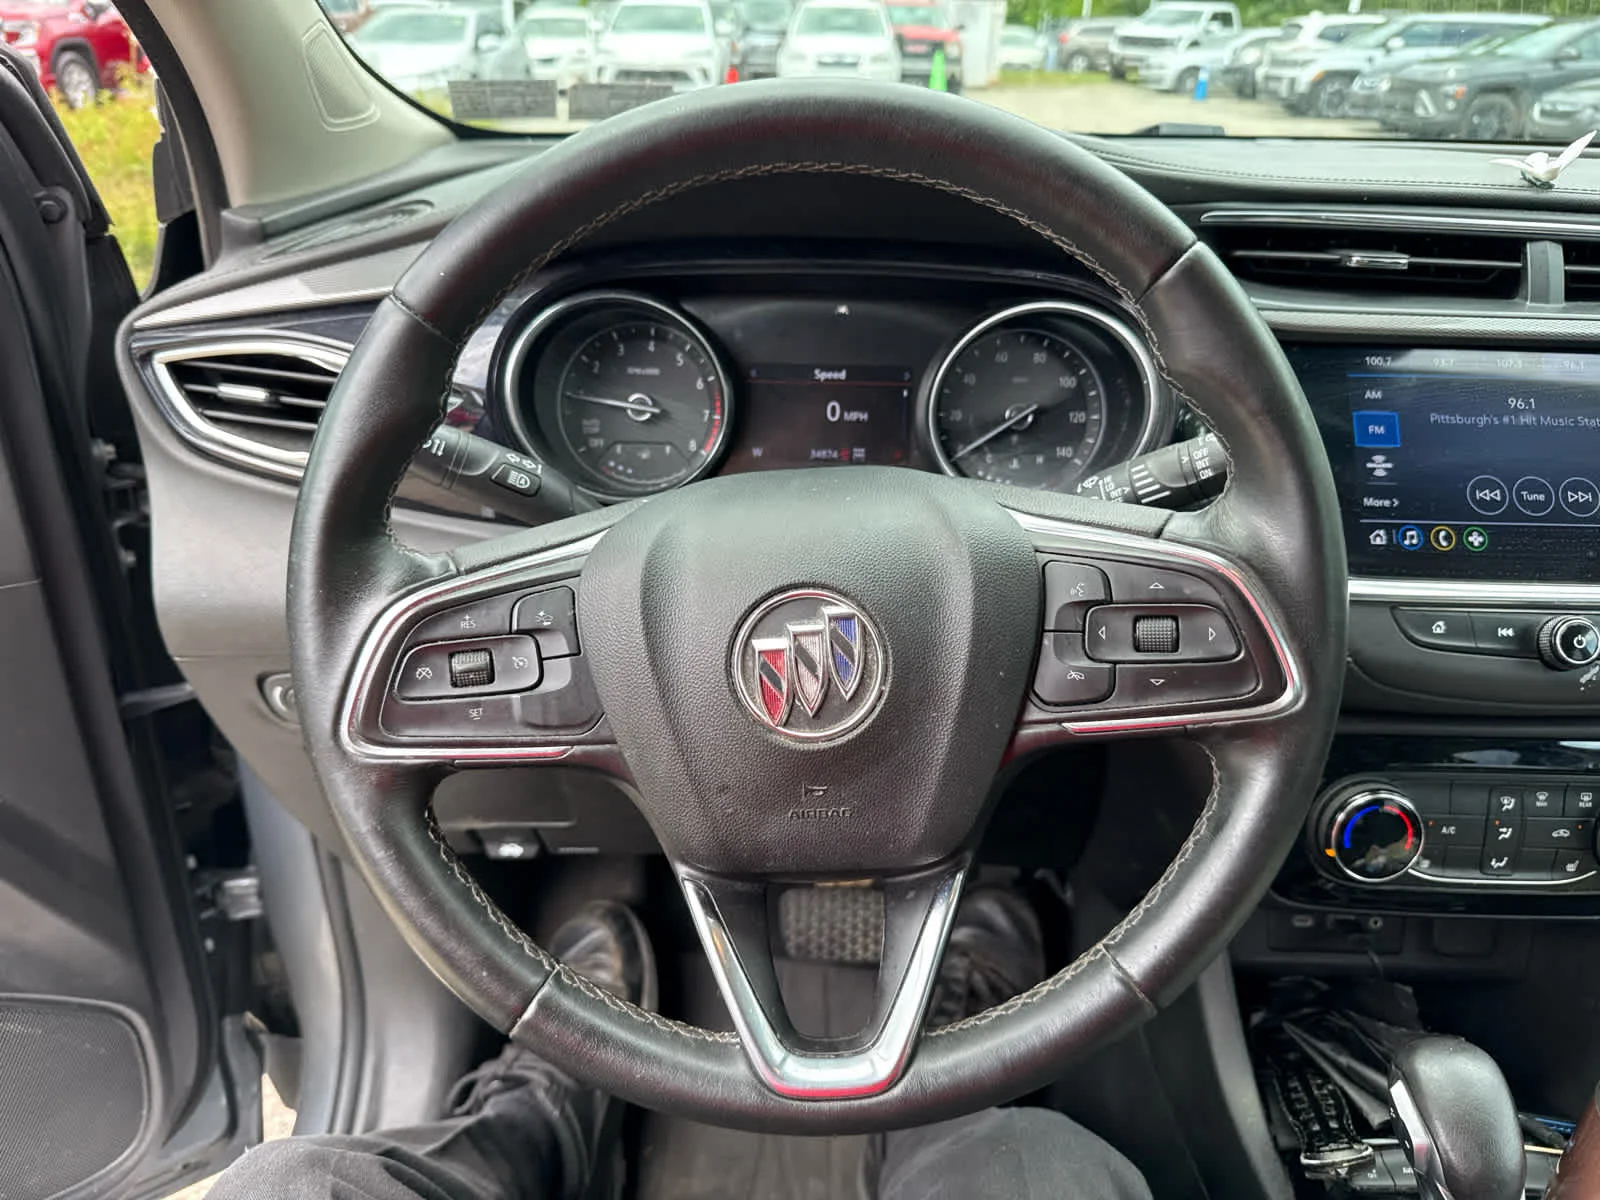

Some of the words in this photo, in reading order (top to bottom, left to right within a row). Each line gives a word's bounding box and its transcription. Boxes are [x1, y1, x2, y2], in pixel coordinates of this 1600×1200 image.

[676, 353, 684, 367] 5
[1033, 352, 1046, 363] 80
[1365, 356, 1391, 367] 100.7
[814, 369, 846, 381] Speed
[696, 377, 704, 390] 6
[1058, 377, 1076, 388] 100
[1364, 389, 1382, 400] AM
[1508, 398, 1536, 410] 96.1
[703, 409, 710, 422] 7
[827, 401, 841, 422] 0
[844, 411, 868, 422] MPH
[1069, 412, 1086, 423] 120
[1430, 412, 1500, 428] Pittsburgh's
[1502, 415, 1515, 425] #1
[1519, 416, 1538, 426] Hit
[1540, 416, 1575, 427] Music
[1368, 424, 1385, 436] FM
[689, 440, 697, 452] 8
[752, 447, 763, 457] W
[1056, 448, 1072, 458] 140
[1200, 468, 1214, 479] ON
[1363, 497, 1391, 507] More
[1521, 491, 1545, 502] Tune
[460, 620, 477, 629] RES
[469, 707, 483, 718] SET
[1441, 826, 1456, 834] A/C
